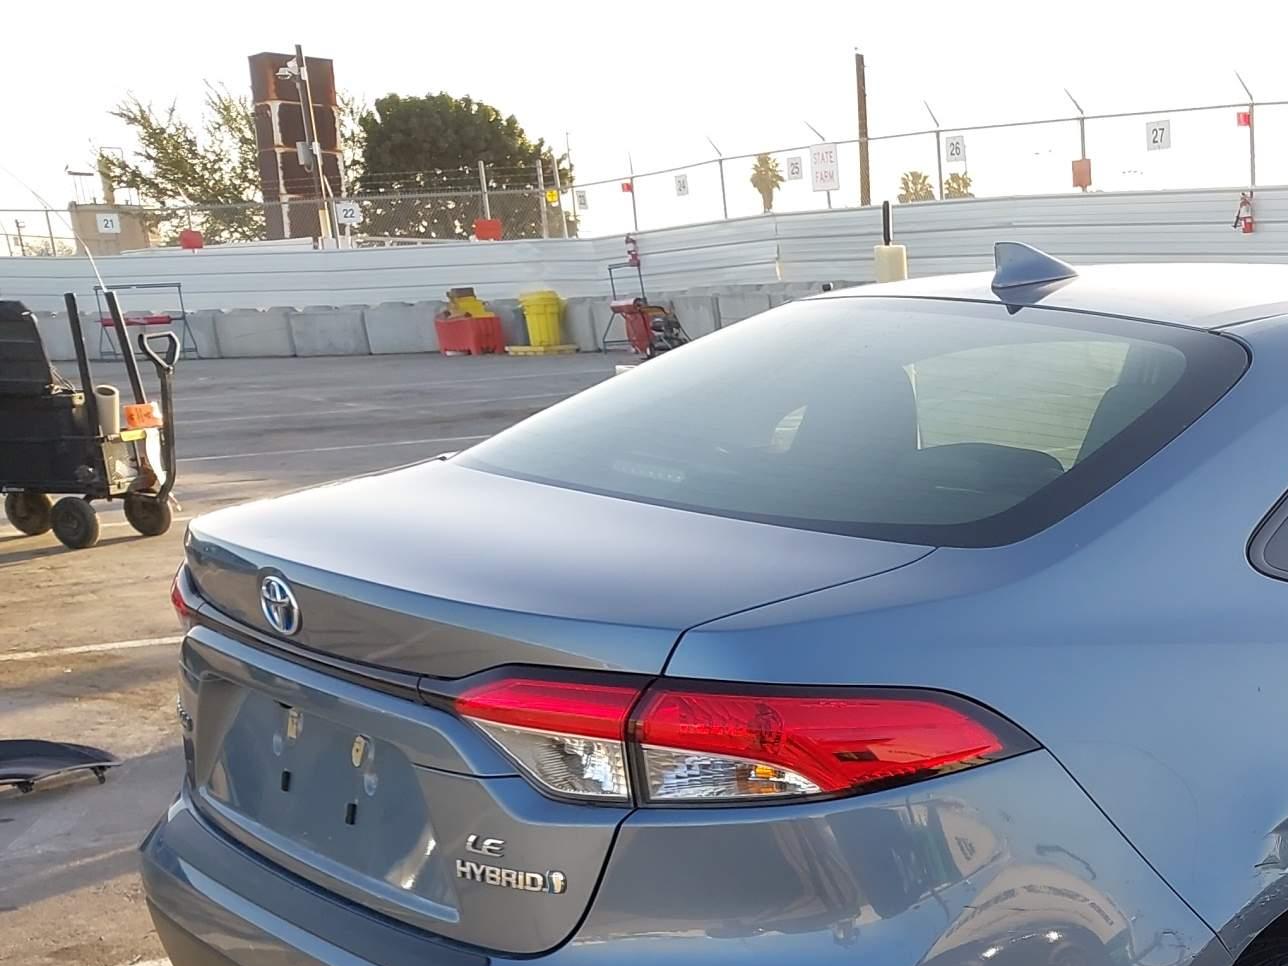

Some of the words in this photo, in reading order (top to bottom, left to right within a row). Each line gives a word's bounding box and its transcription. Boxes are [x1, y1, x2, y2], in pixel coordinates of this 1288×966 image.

[1151, 127, 1165, 144] 27
[949, 141, 961, 156] 26
[813, 150, 835, 165] STATE
[790, 162, 800, 175] 25
[815, 169, 834, 183] FARM
[342, 208, 355, 218] 22
[103, 218, 114, 229] 21
[464, 834, 505, 858] LE
[455, 859, 544, 892] HYBRID
